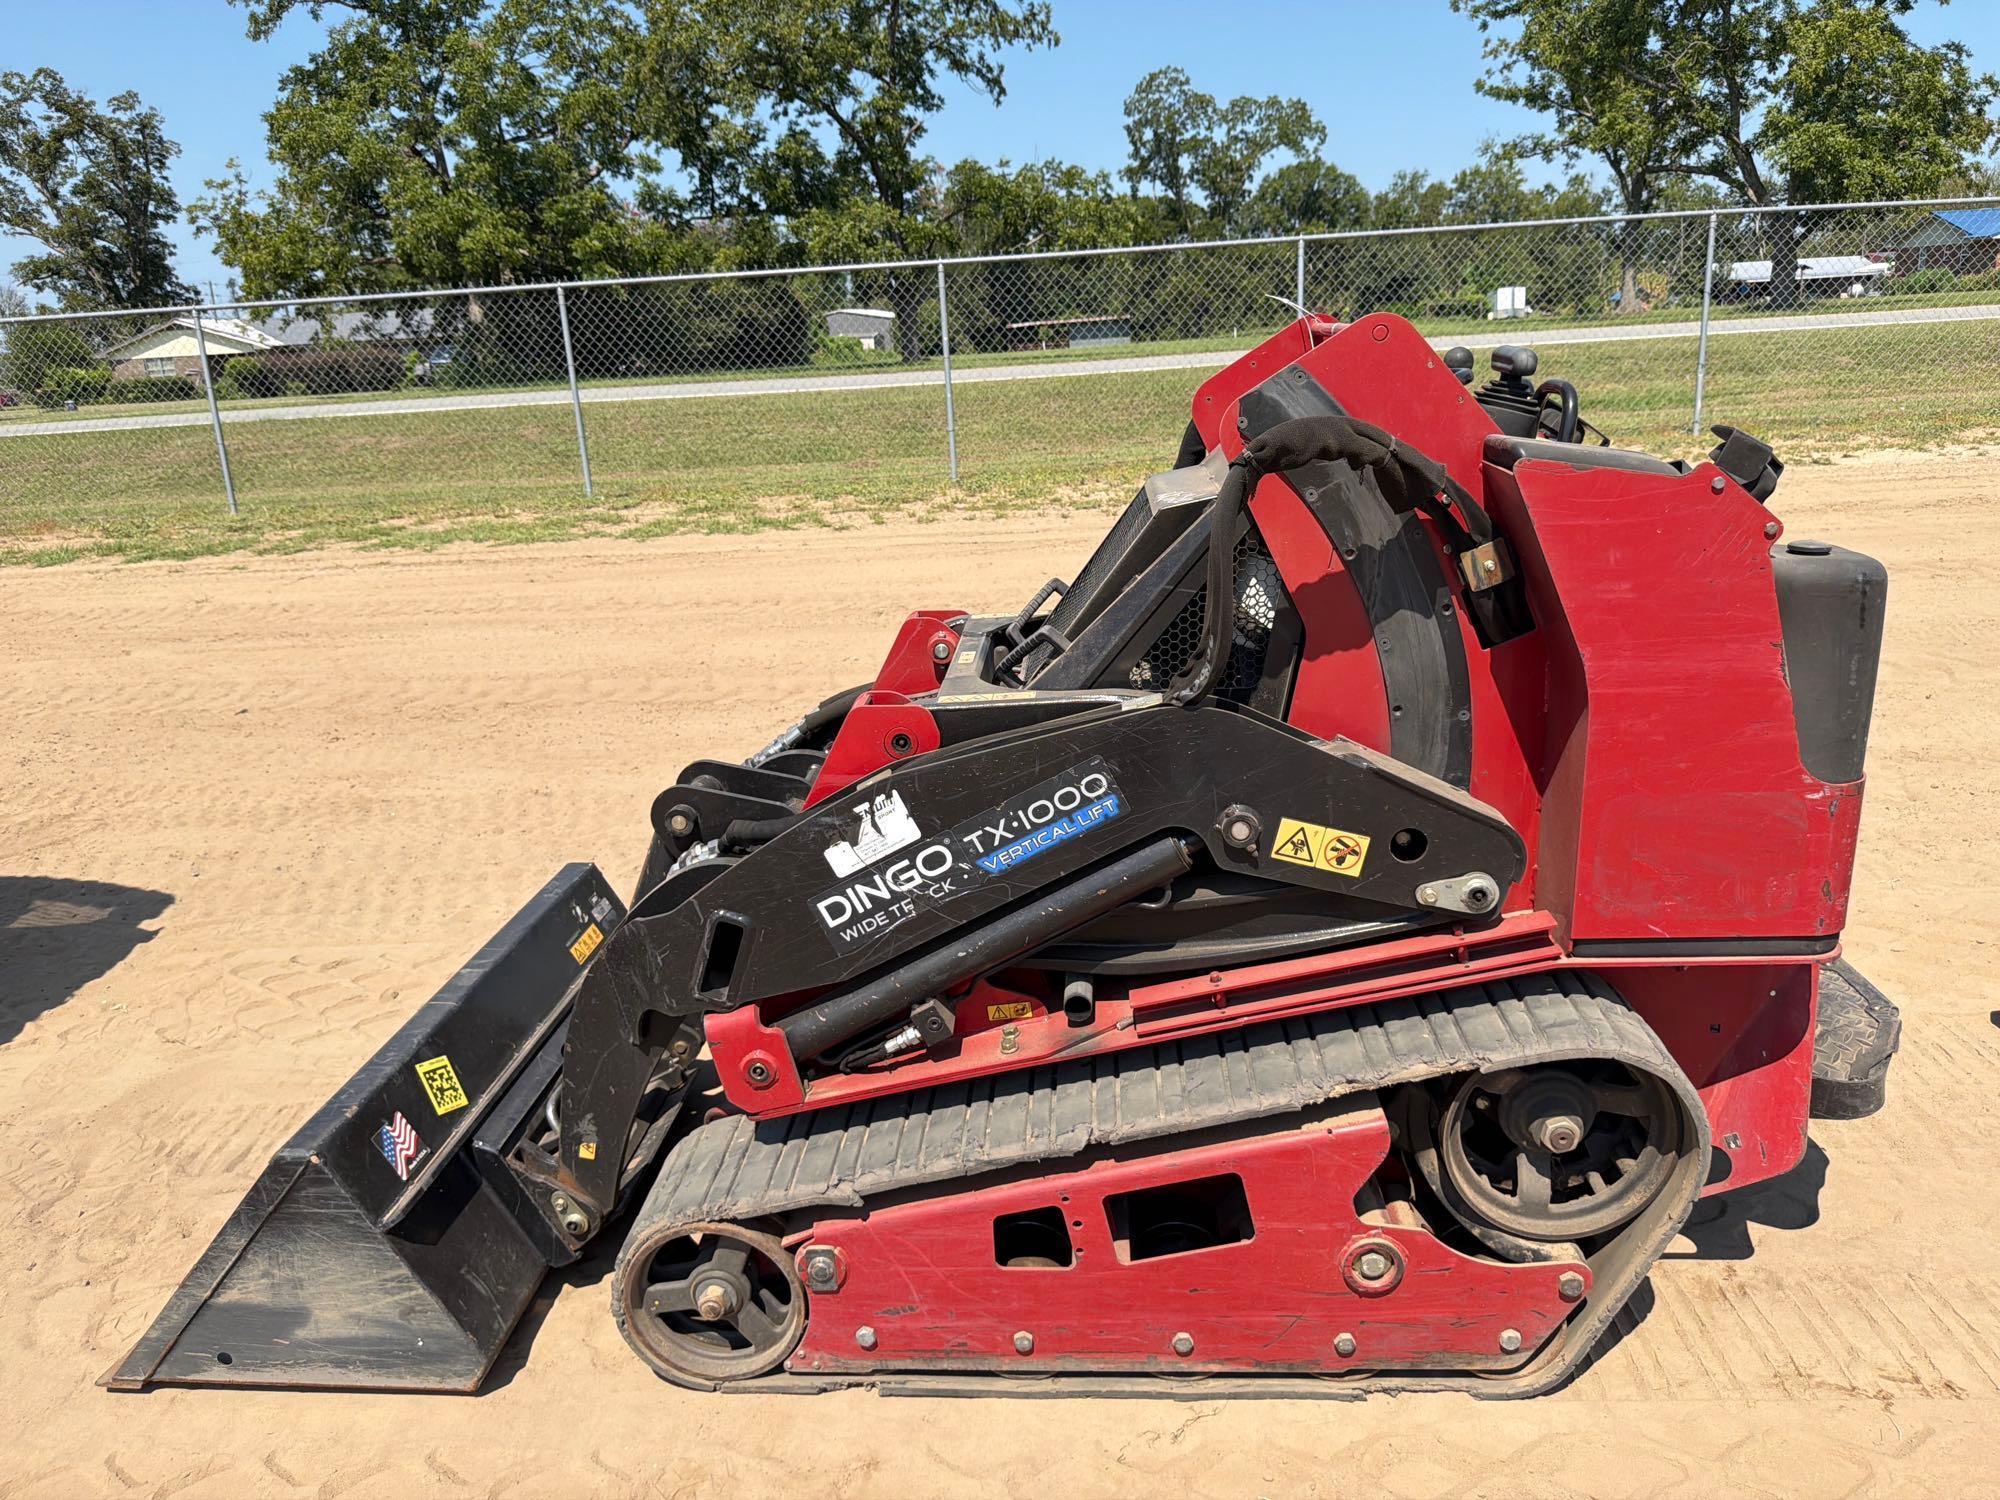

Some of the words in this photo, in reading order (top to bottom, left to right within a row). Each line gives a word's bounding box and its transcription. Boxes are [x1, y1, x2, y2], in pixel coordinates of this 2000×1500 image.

[983, 822, 1077, 869] VERTICAL
[1077, 799, 1116, 825] LIFT
[816, 845, 952, 928] DINGO
[839, 911, 889, 942] WIDE
